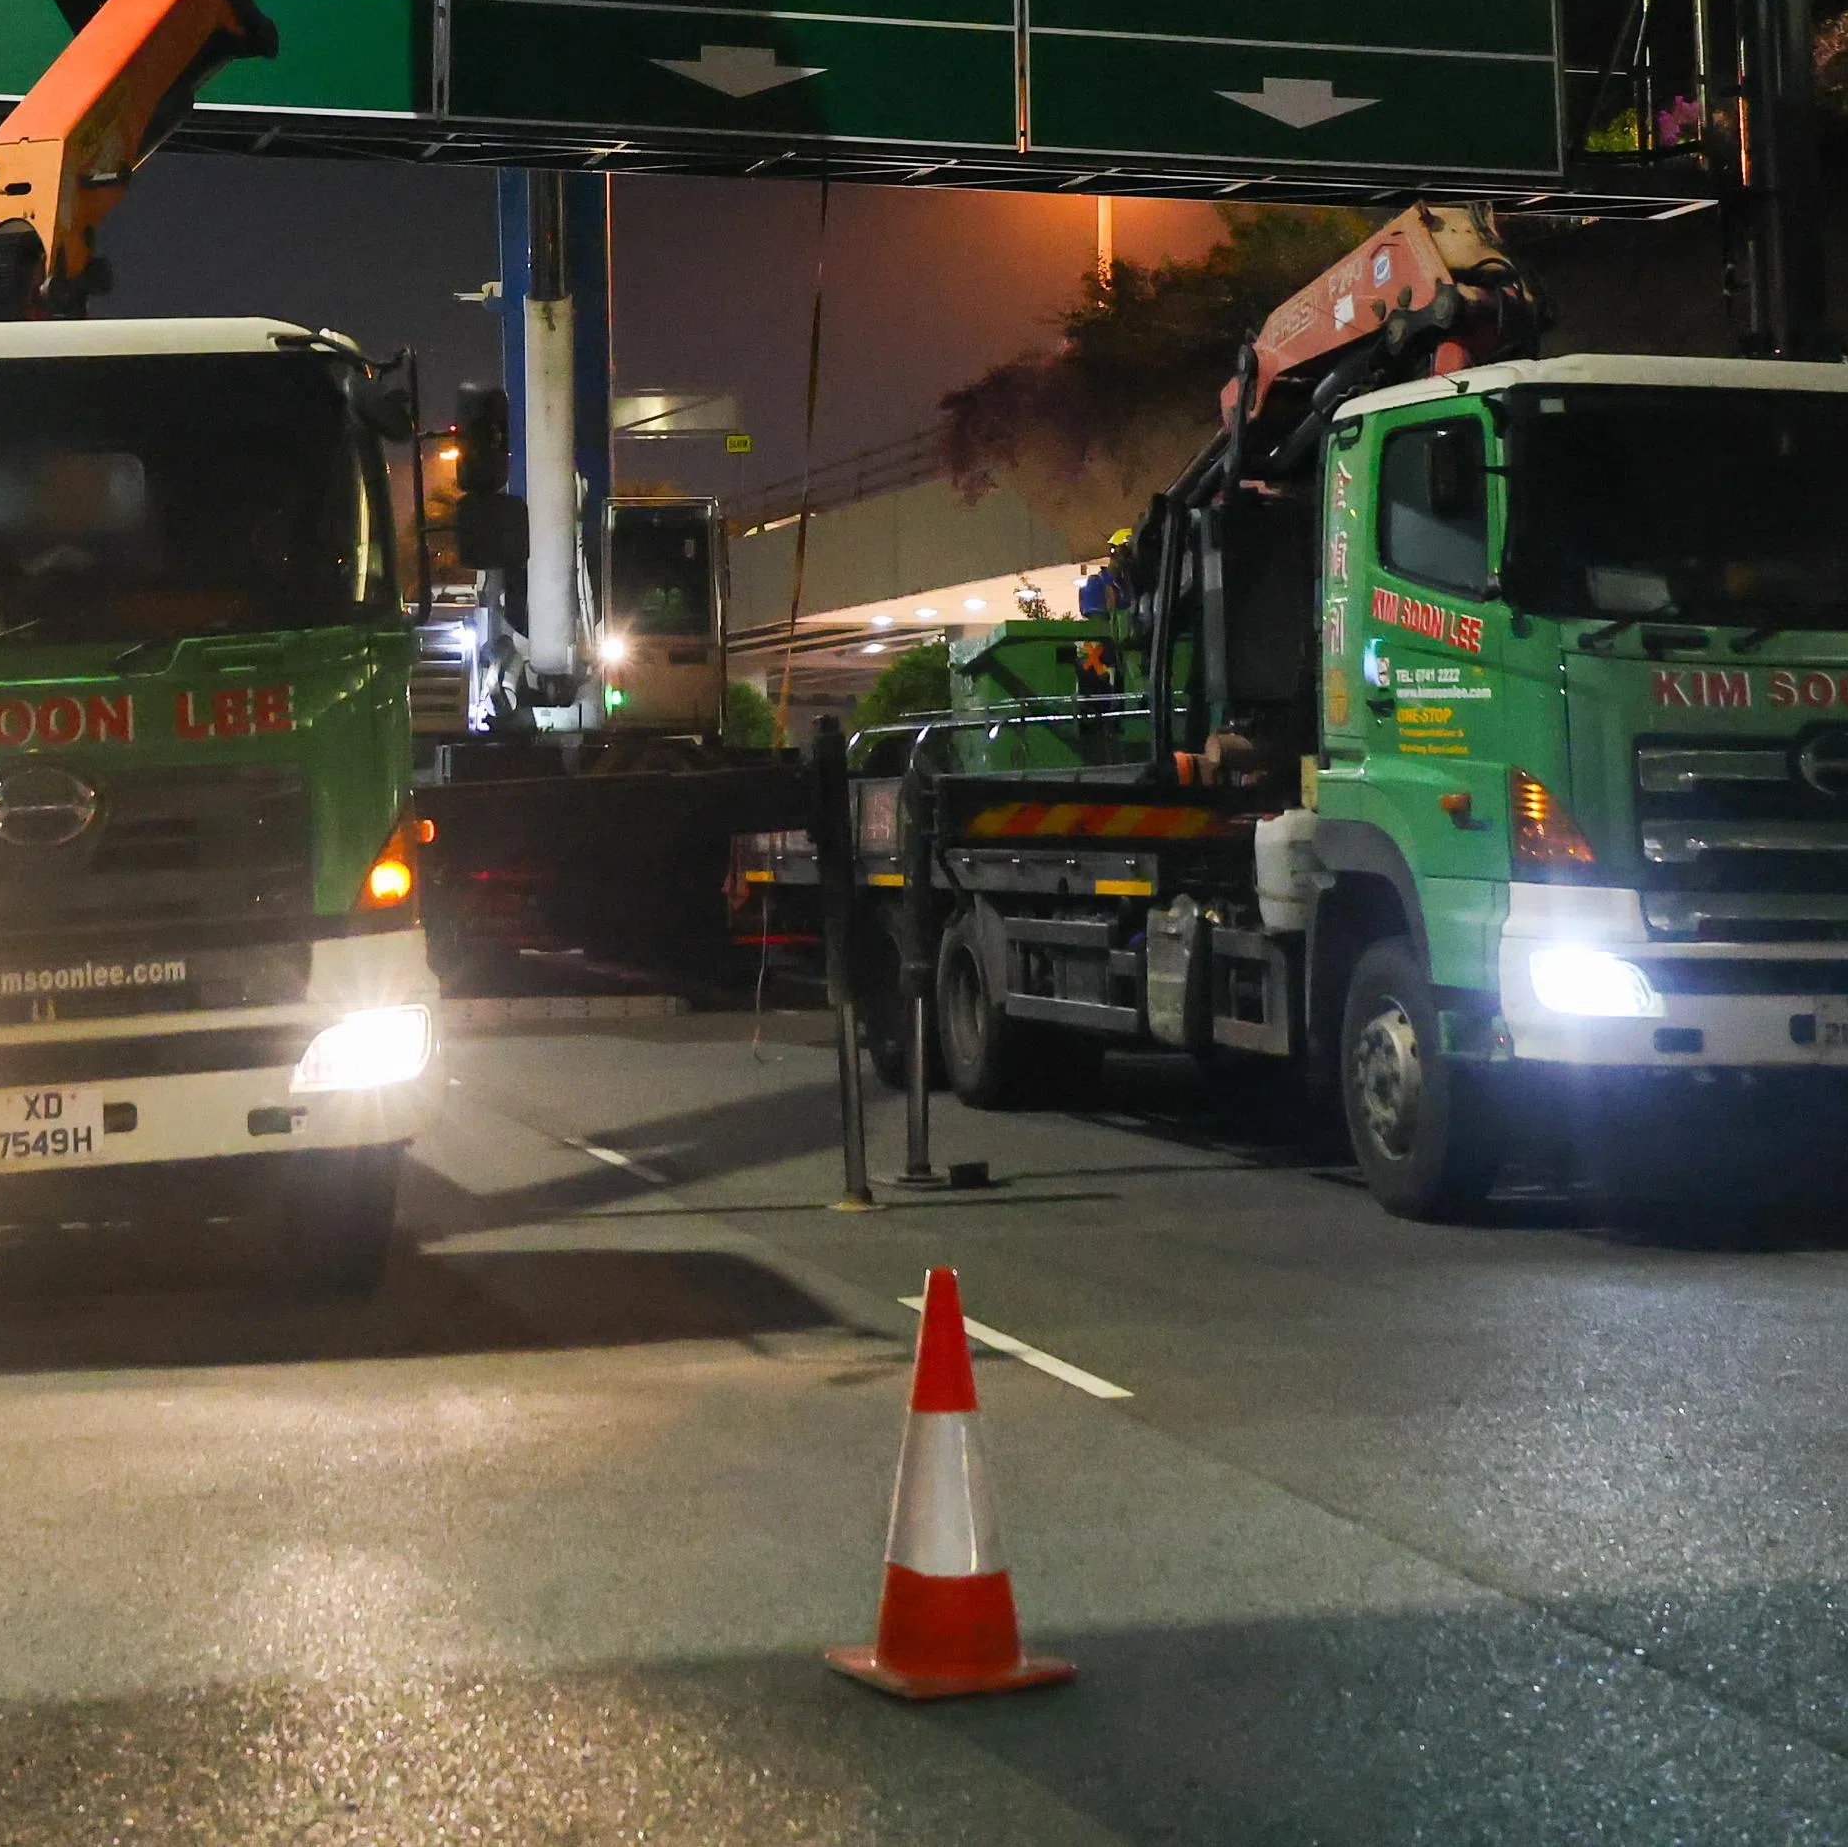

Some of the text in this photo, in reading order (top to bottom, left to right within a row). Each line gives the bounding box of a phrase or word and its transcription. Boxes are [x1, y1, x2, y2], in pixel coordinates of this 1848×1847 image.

[1372, 586, 1483, 654] KIM SOON LEE
[1652, 671, 1751, 707] KIM
[174, 687, 297, 740] LEE
[24, 1092, 63, 1121] XD
